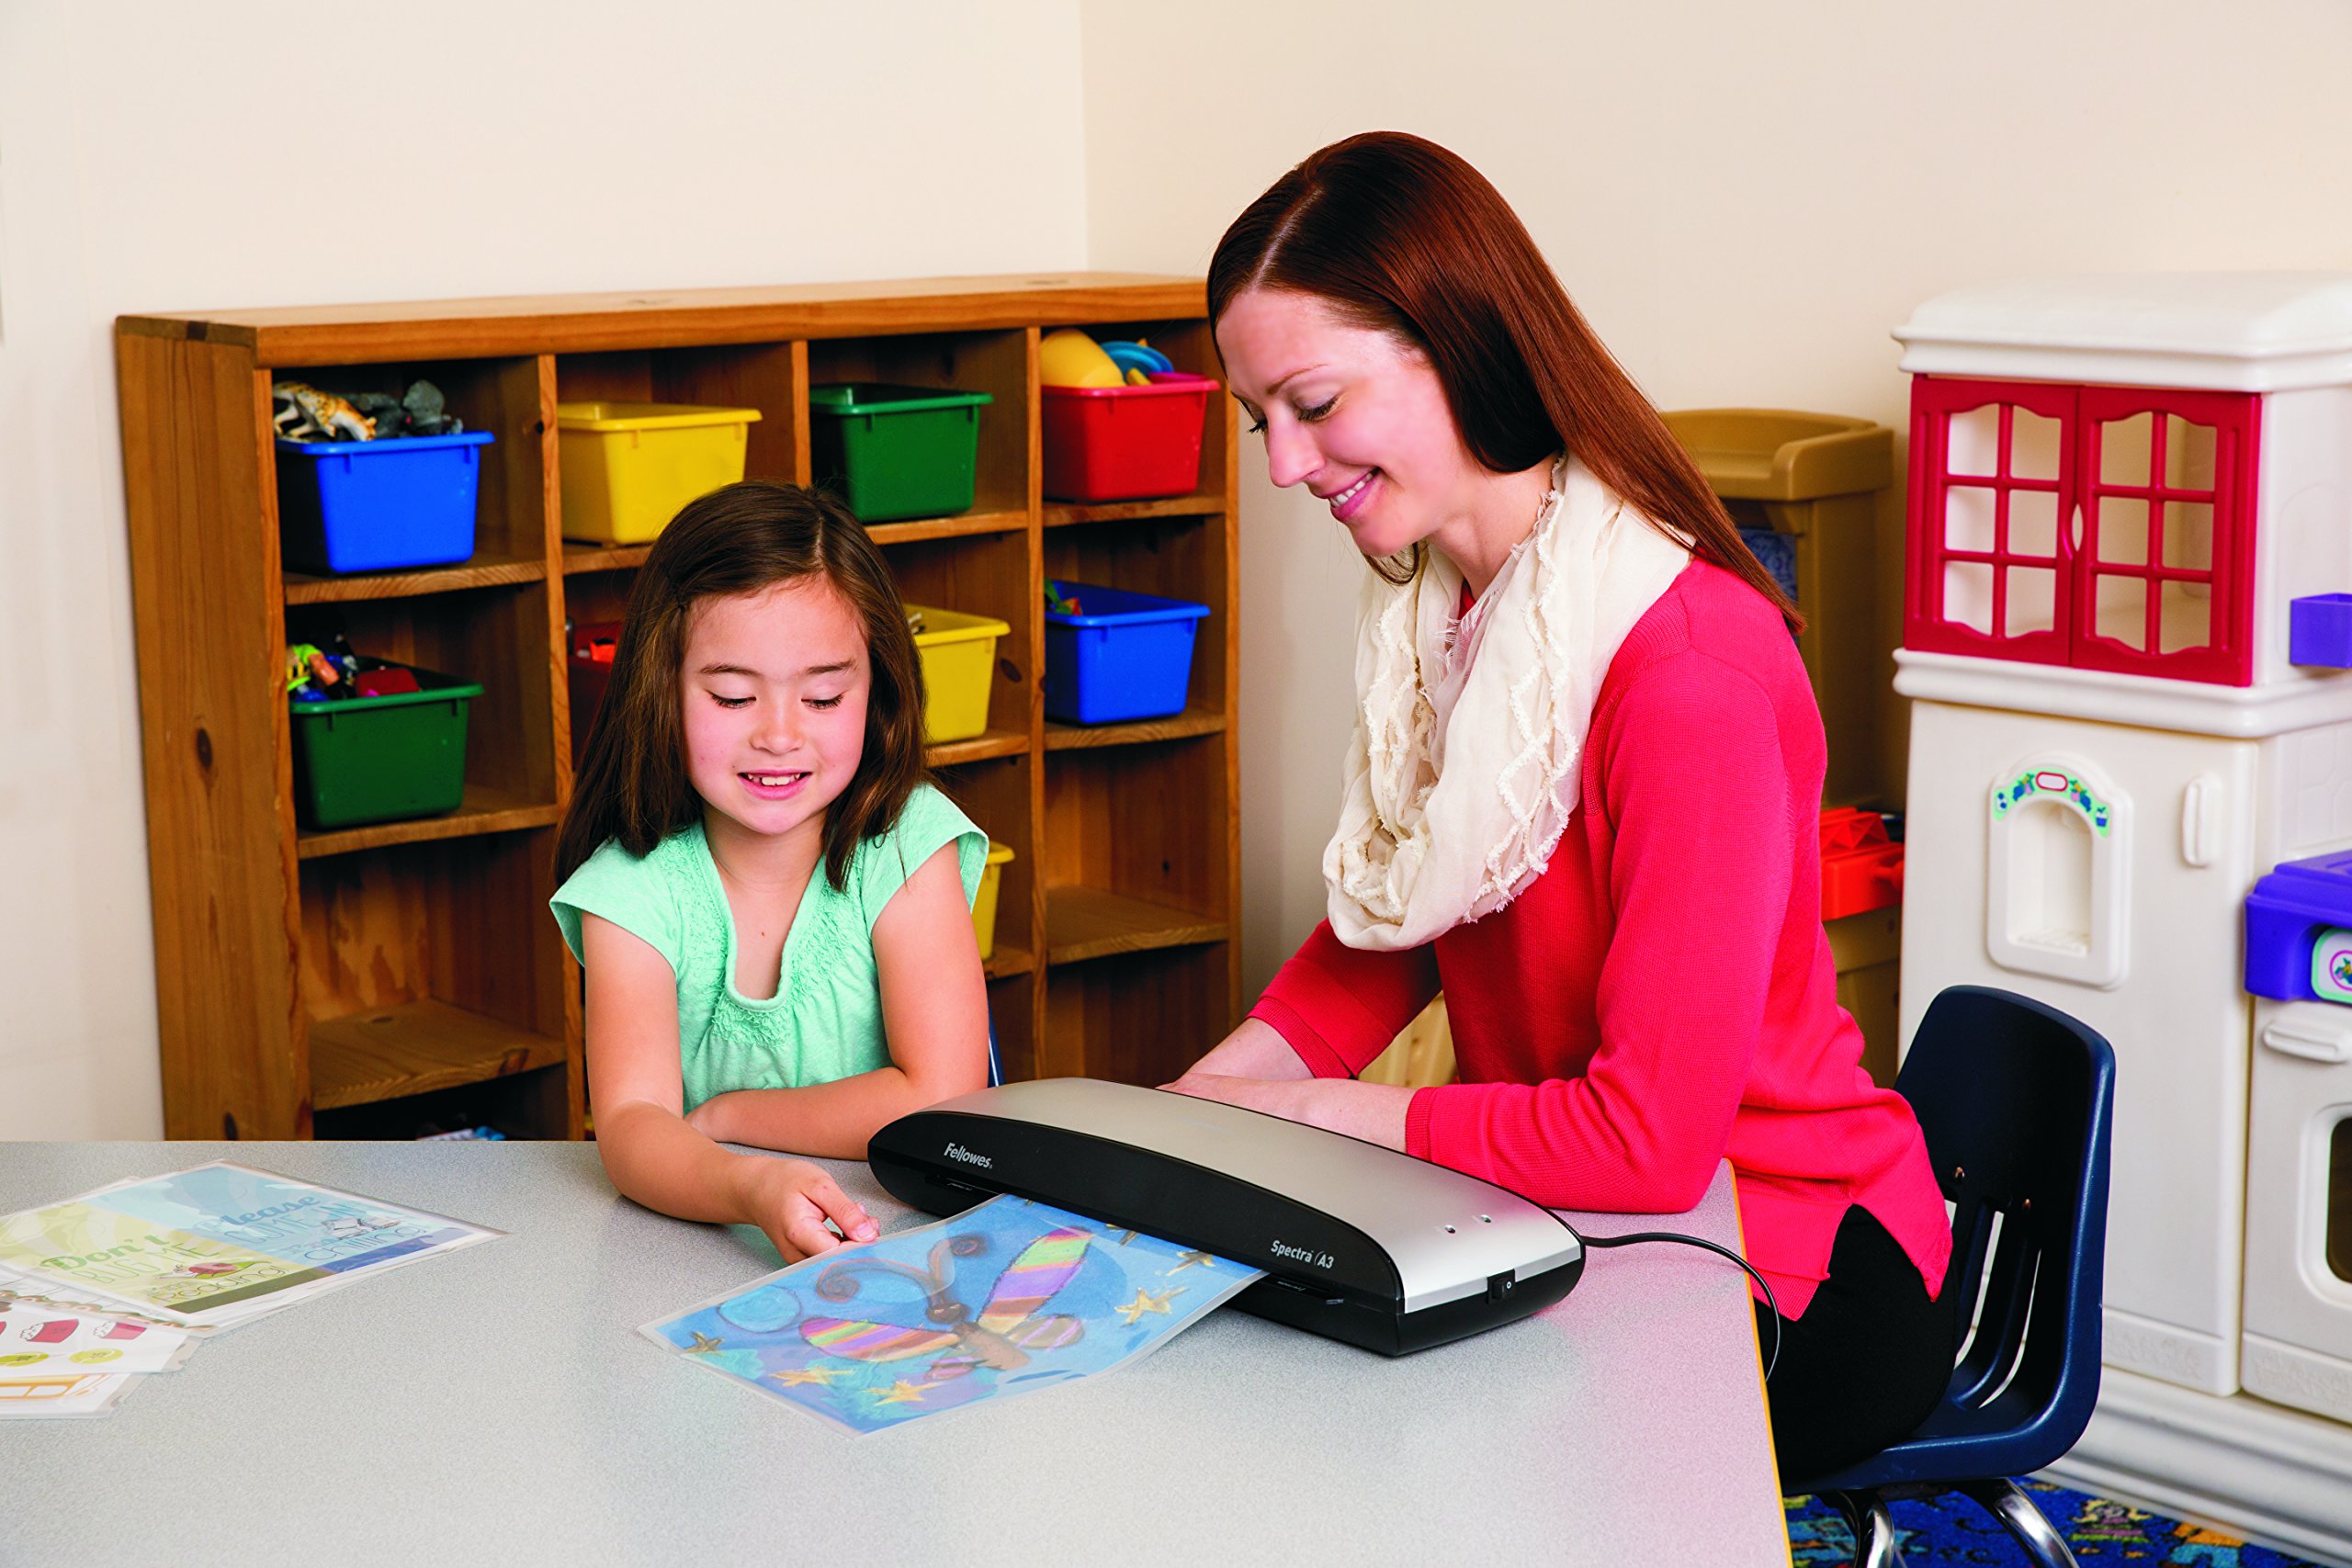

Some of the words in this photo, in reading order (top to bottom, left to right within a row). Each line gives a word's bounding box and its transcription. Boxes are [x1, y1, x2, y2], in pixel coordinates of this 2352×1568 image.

[944, 1142, 991, 1168] Fellowes
[40, 1234, 169, 1271] Don't
[72, 1258, 161, 1284] BUG
[146, 1242, 220, 1264] ME
[1271, 1240, 1313, 1263] Spectra
